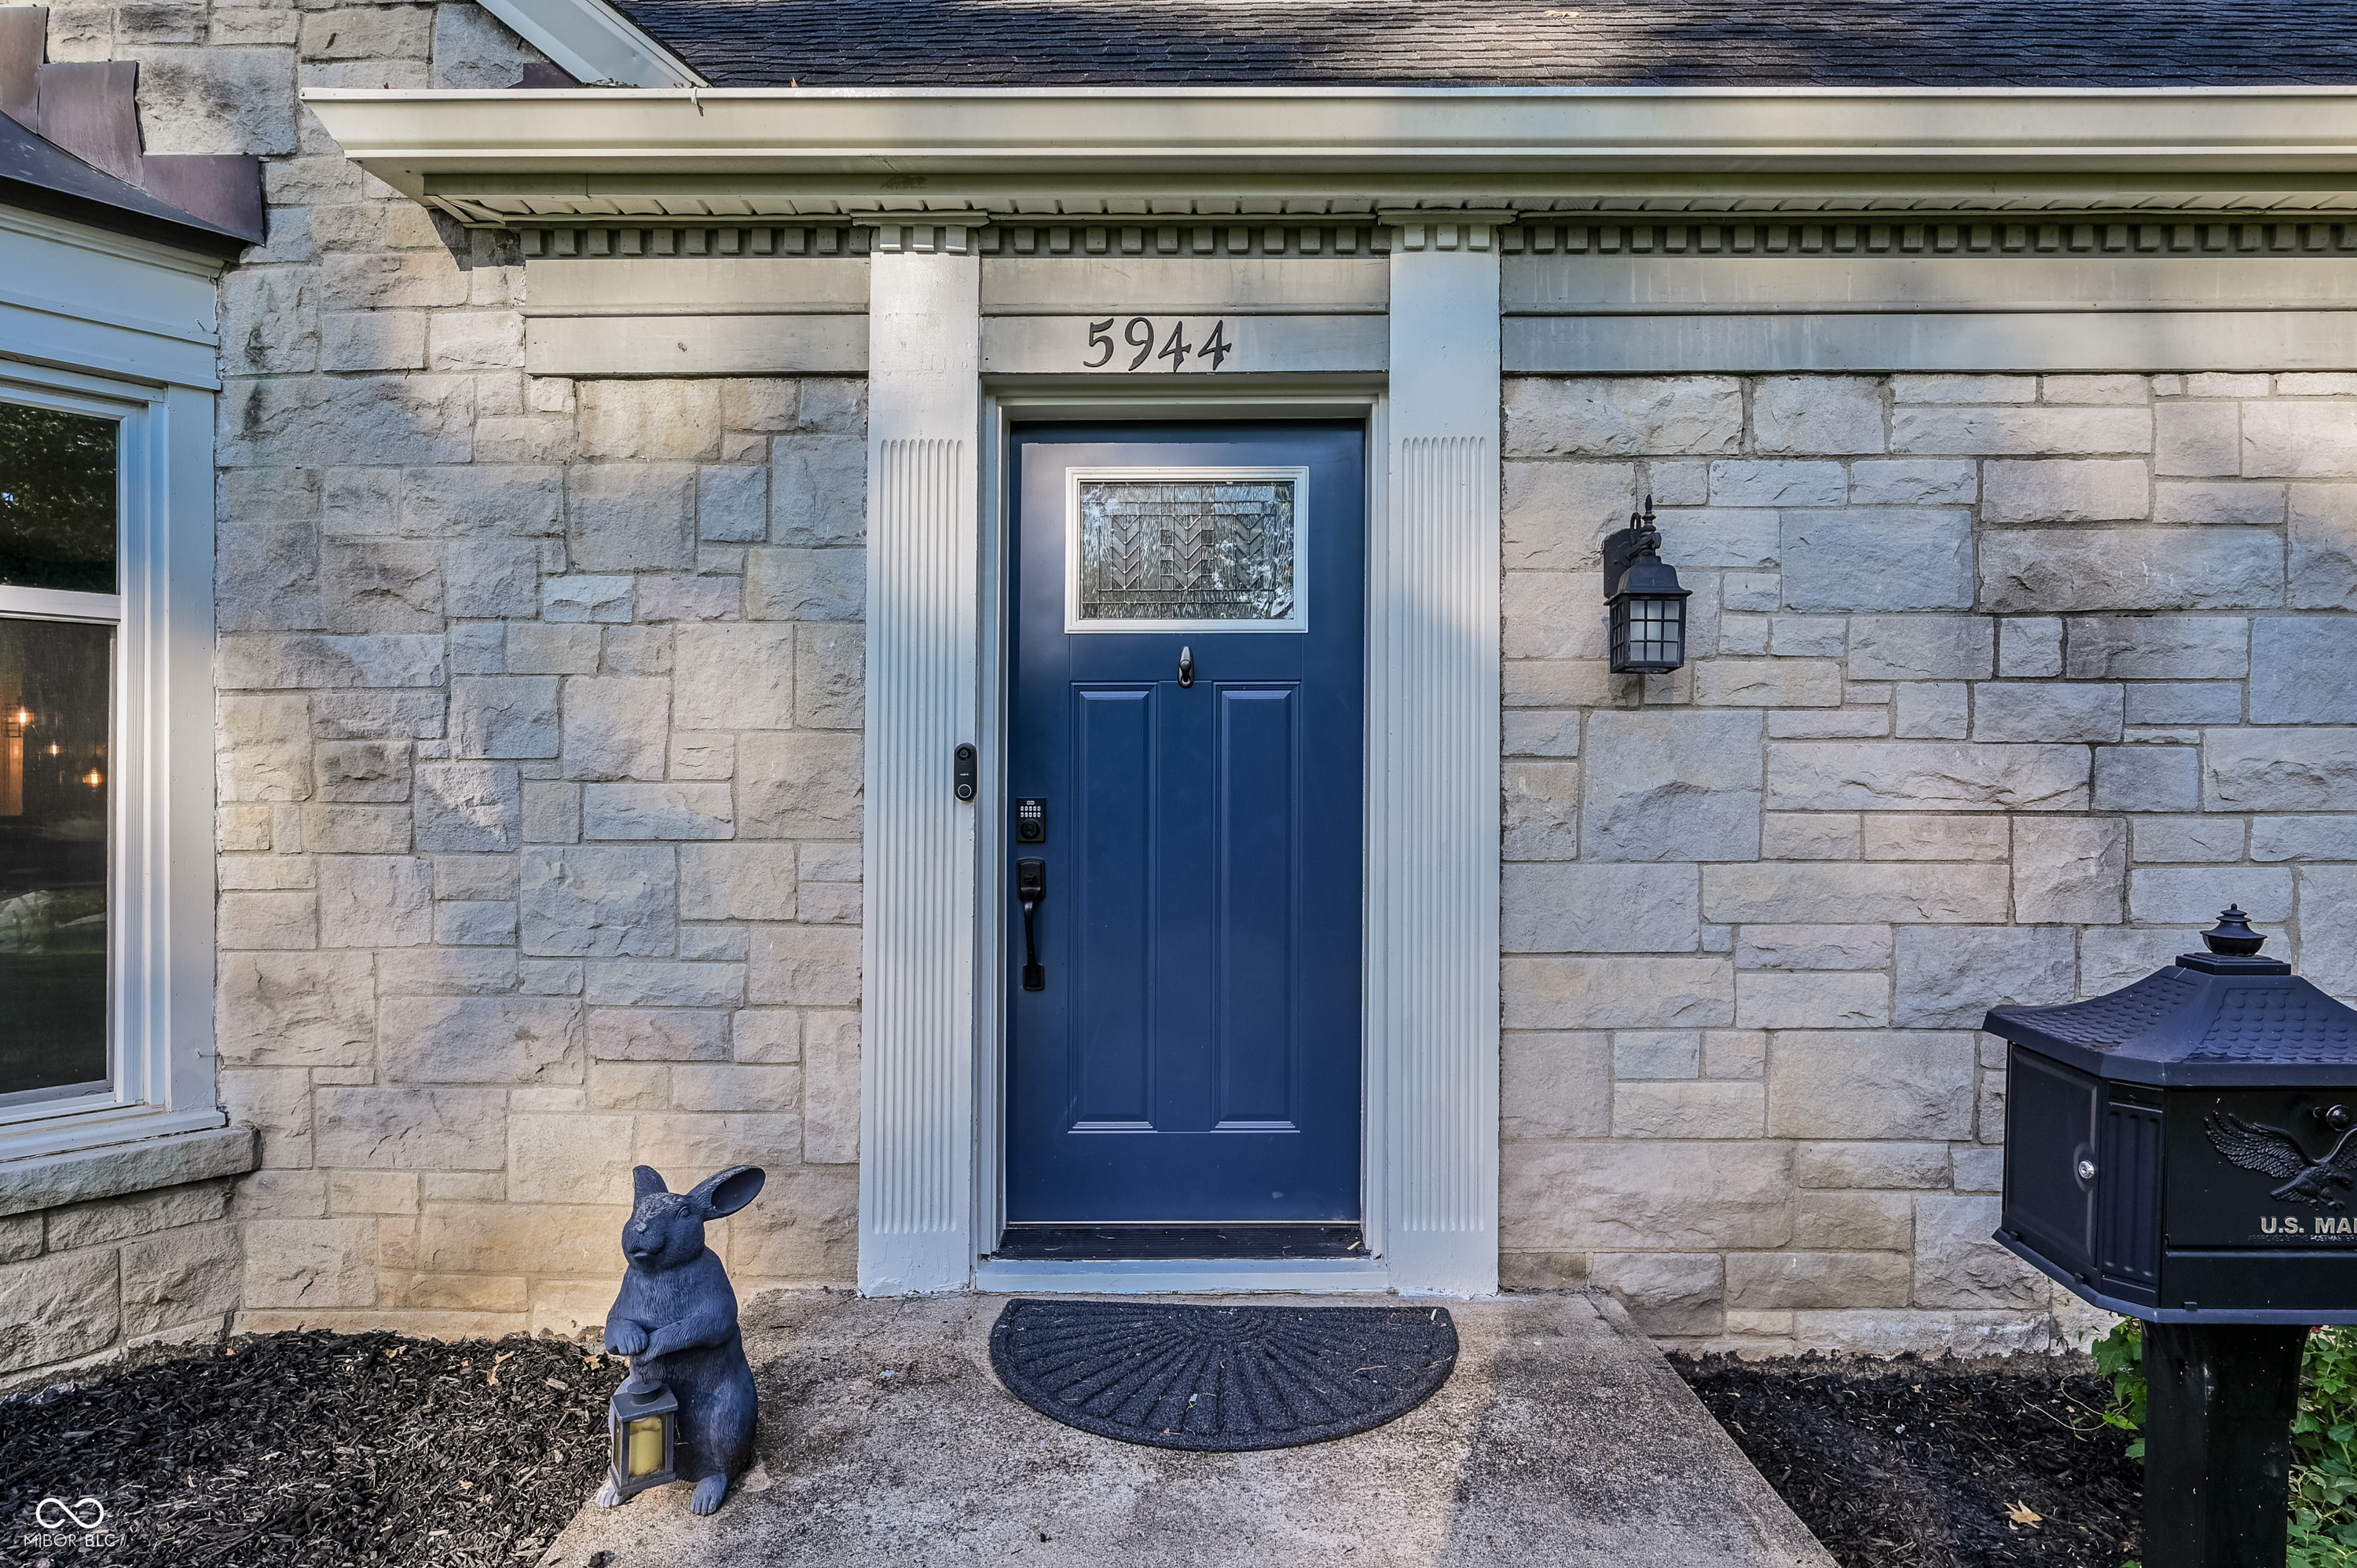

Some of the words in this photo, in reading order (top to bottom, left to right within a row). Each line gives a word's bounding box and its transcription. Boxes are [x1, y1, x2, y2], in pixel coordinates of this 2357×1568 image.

[1083, 317, 1233, 373] 5944
[2260, 1217, 2305, 1234] U.S.
[2314, 1218, 2357, 1234] MAI
